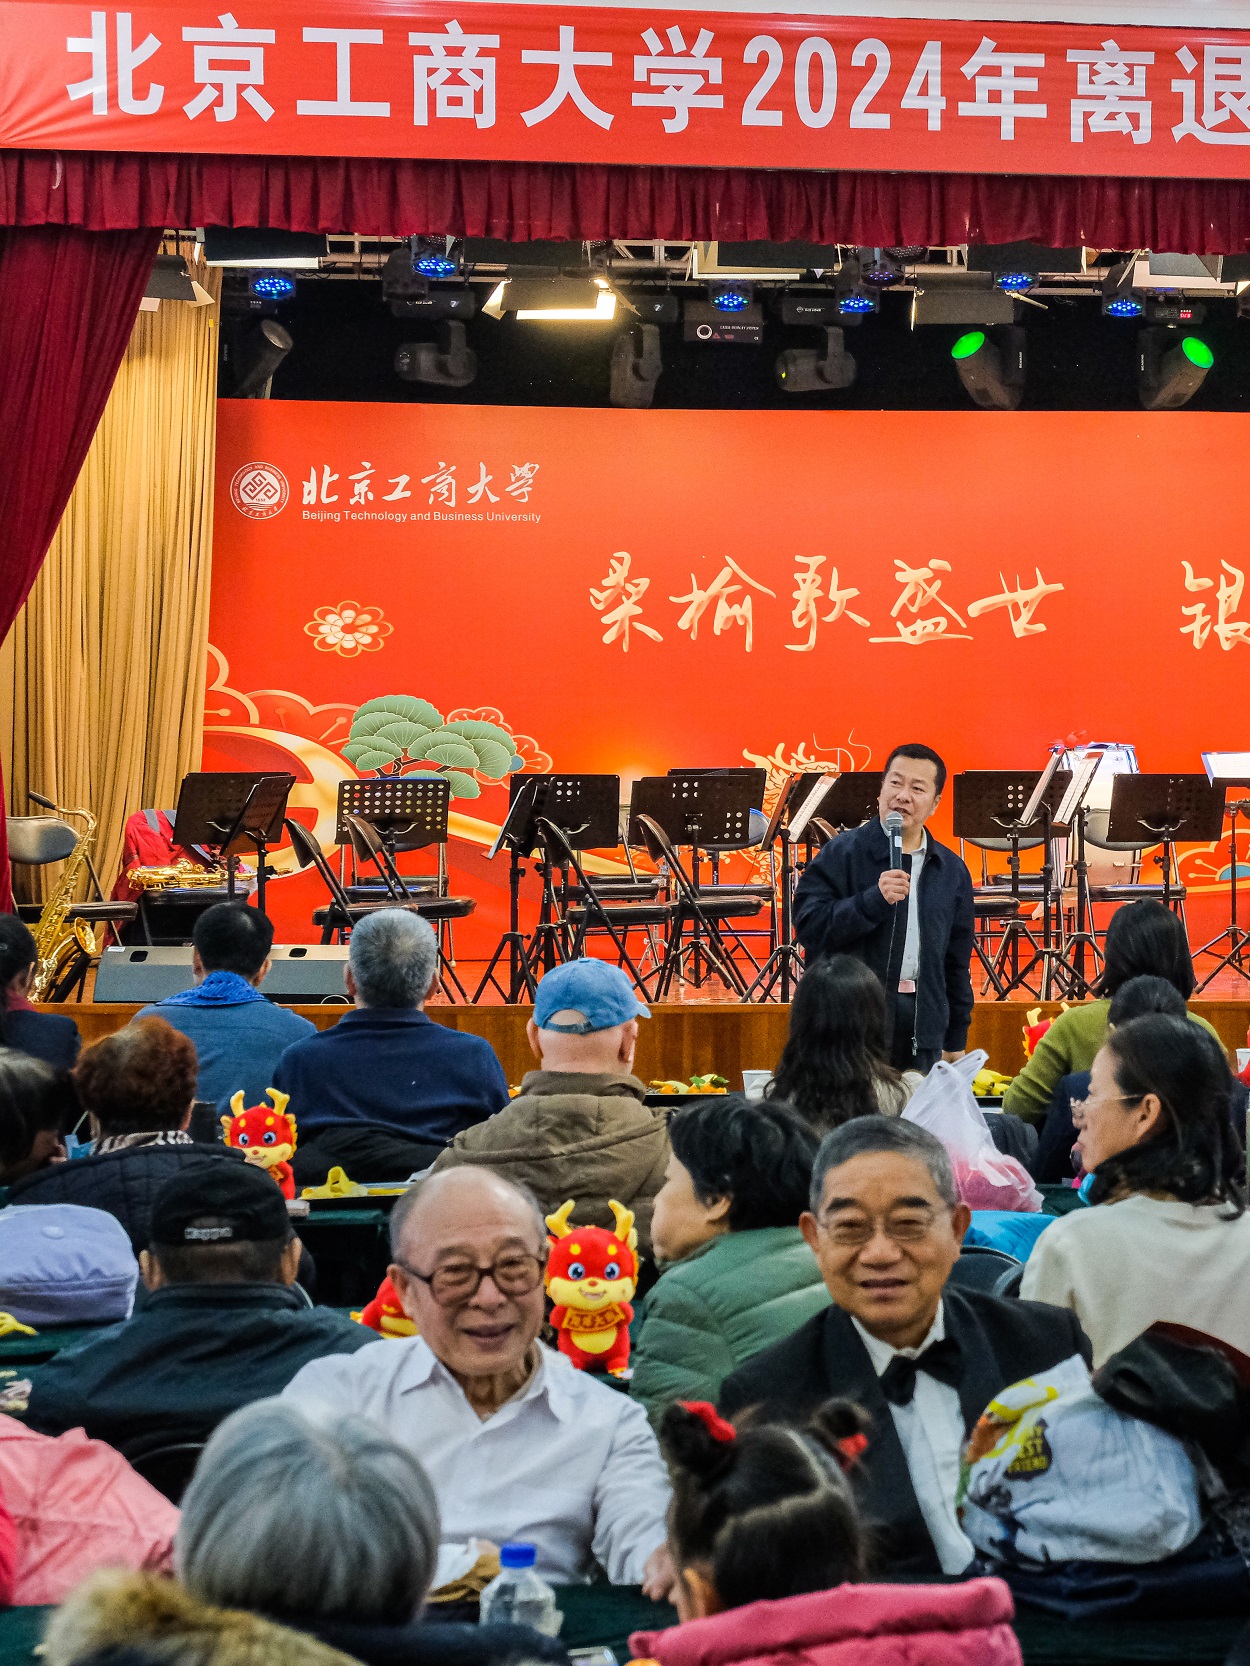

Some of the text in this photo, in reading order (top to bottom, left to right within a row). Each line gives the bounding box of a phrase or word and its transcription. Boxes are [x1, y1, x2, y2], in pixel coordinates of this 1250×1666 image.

[302, 510, 542, 524] Beijing Technology and Business University
[589, 550, 1065, 653] 桑榆歌盛世
